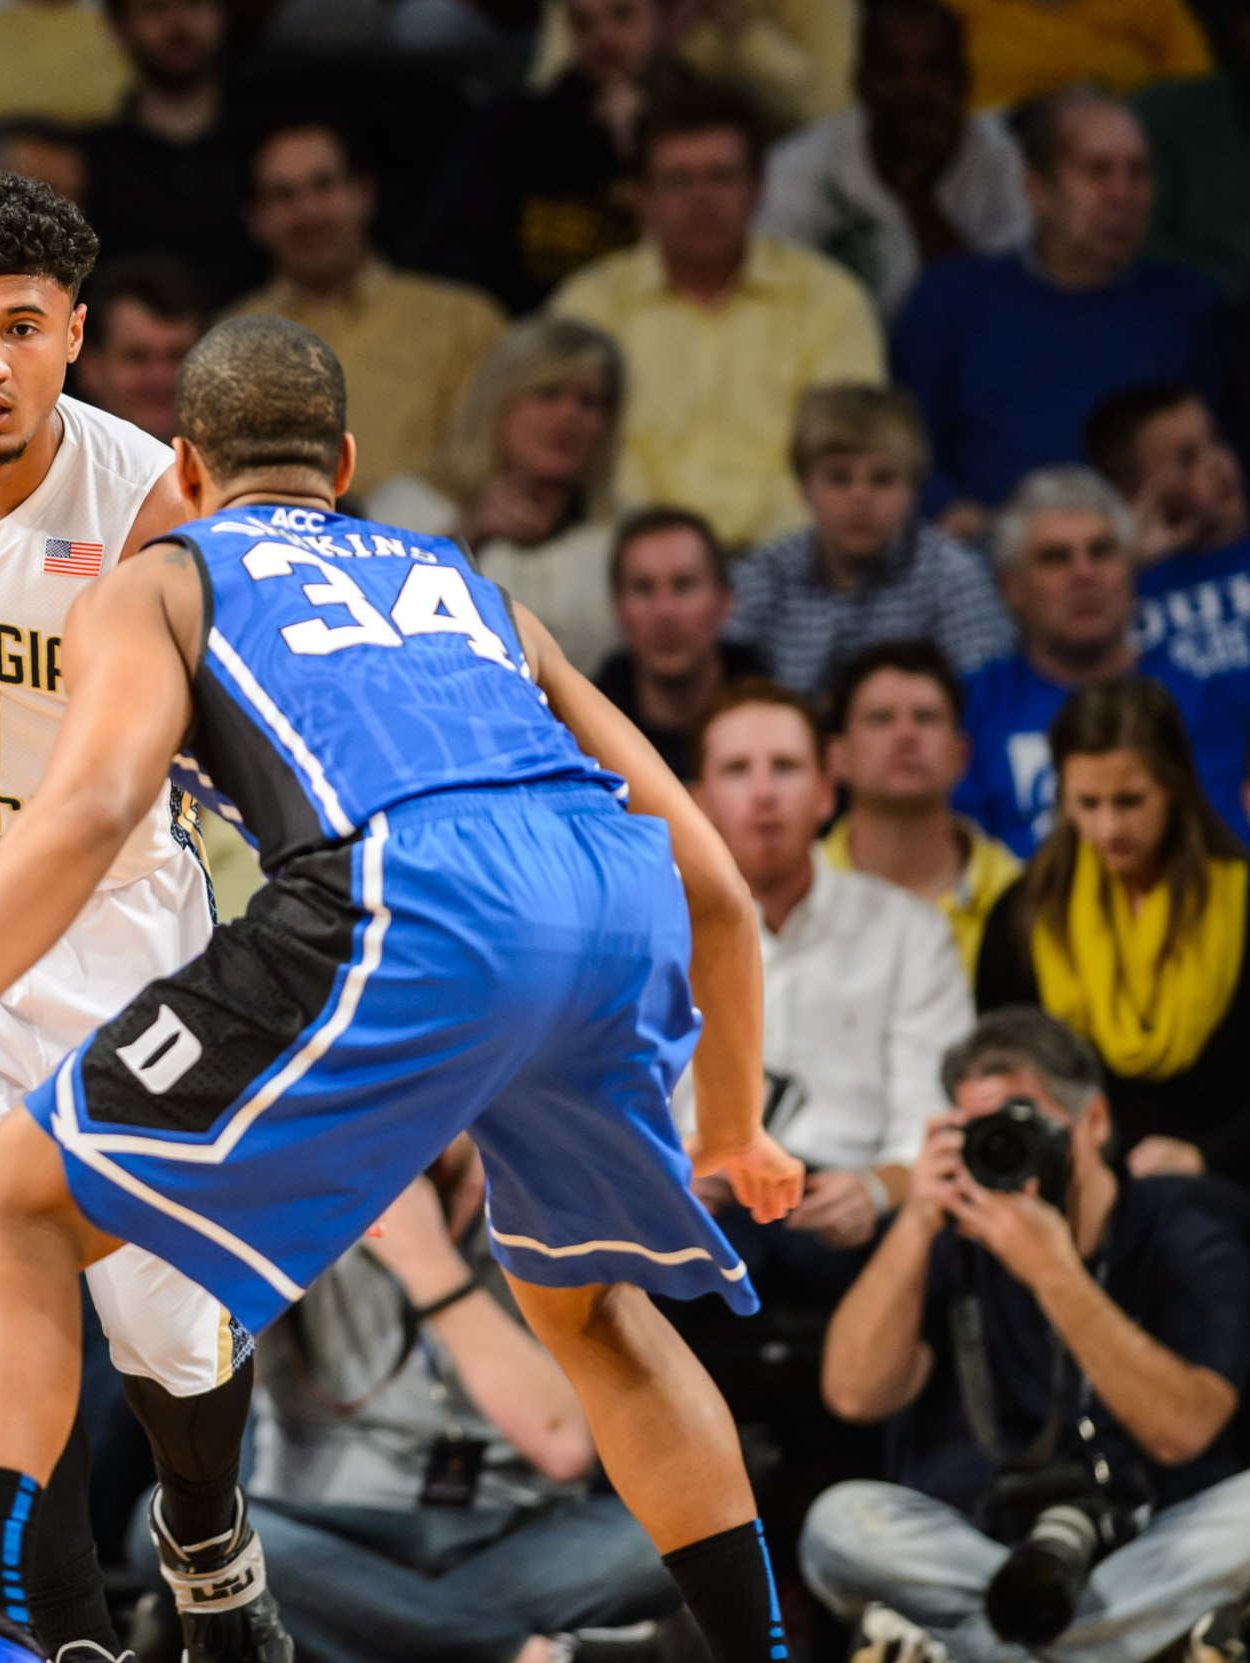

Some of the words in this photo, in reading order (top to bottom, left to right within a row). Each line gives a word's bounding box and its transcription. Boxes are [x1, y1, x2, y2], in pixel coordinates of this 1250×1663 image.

[270, 507, 326, 533] ACC
[241, 540, 517, 672] 34
[115, 1003, 203, 1095] D
